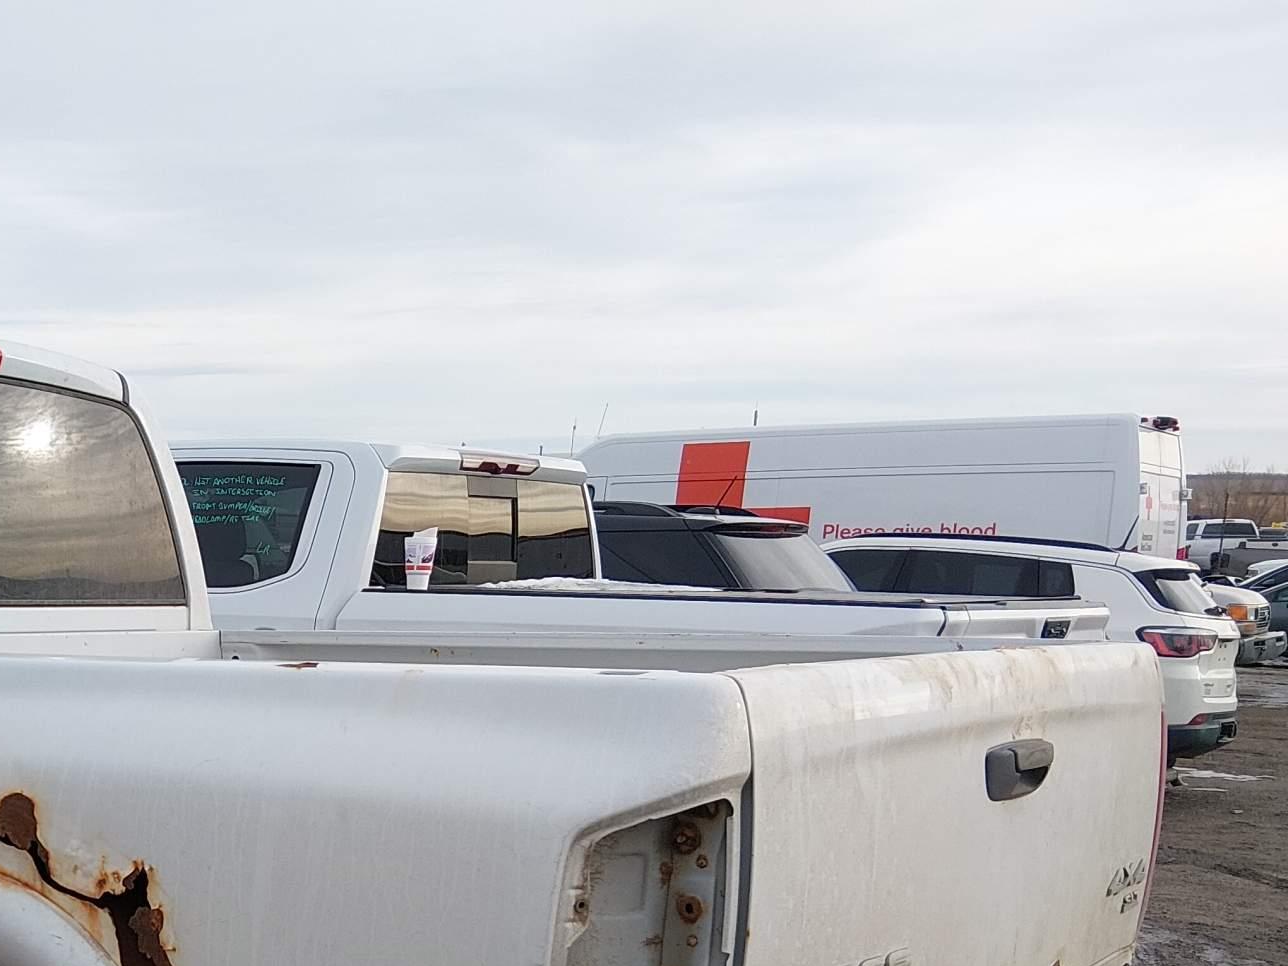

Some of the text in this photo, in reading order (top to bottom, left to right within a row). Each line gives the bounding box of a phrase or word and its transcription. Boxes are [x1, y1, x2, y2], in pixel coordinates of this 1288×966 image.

[213, 475, 253, 487] ANOTHER
[822, 523, 885, 540] Please
[940, 522, 997, 536] blood
